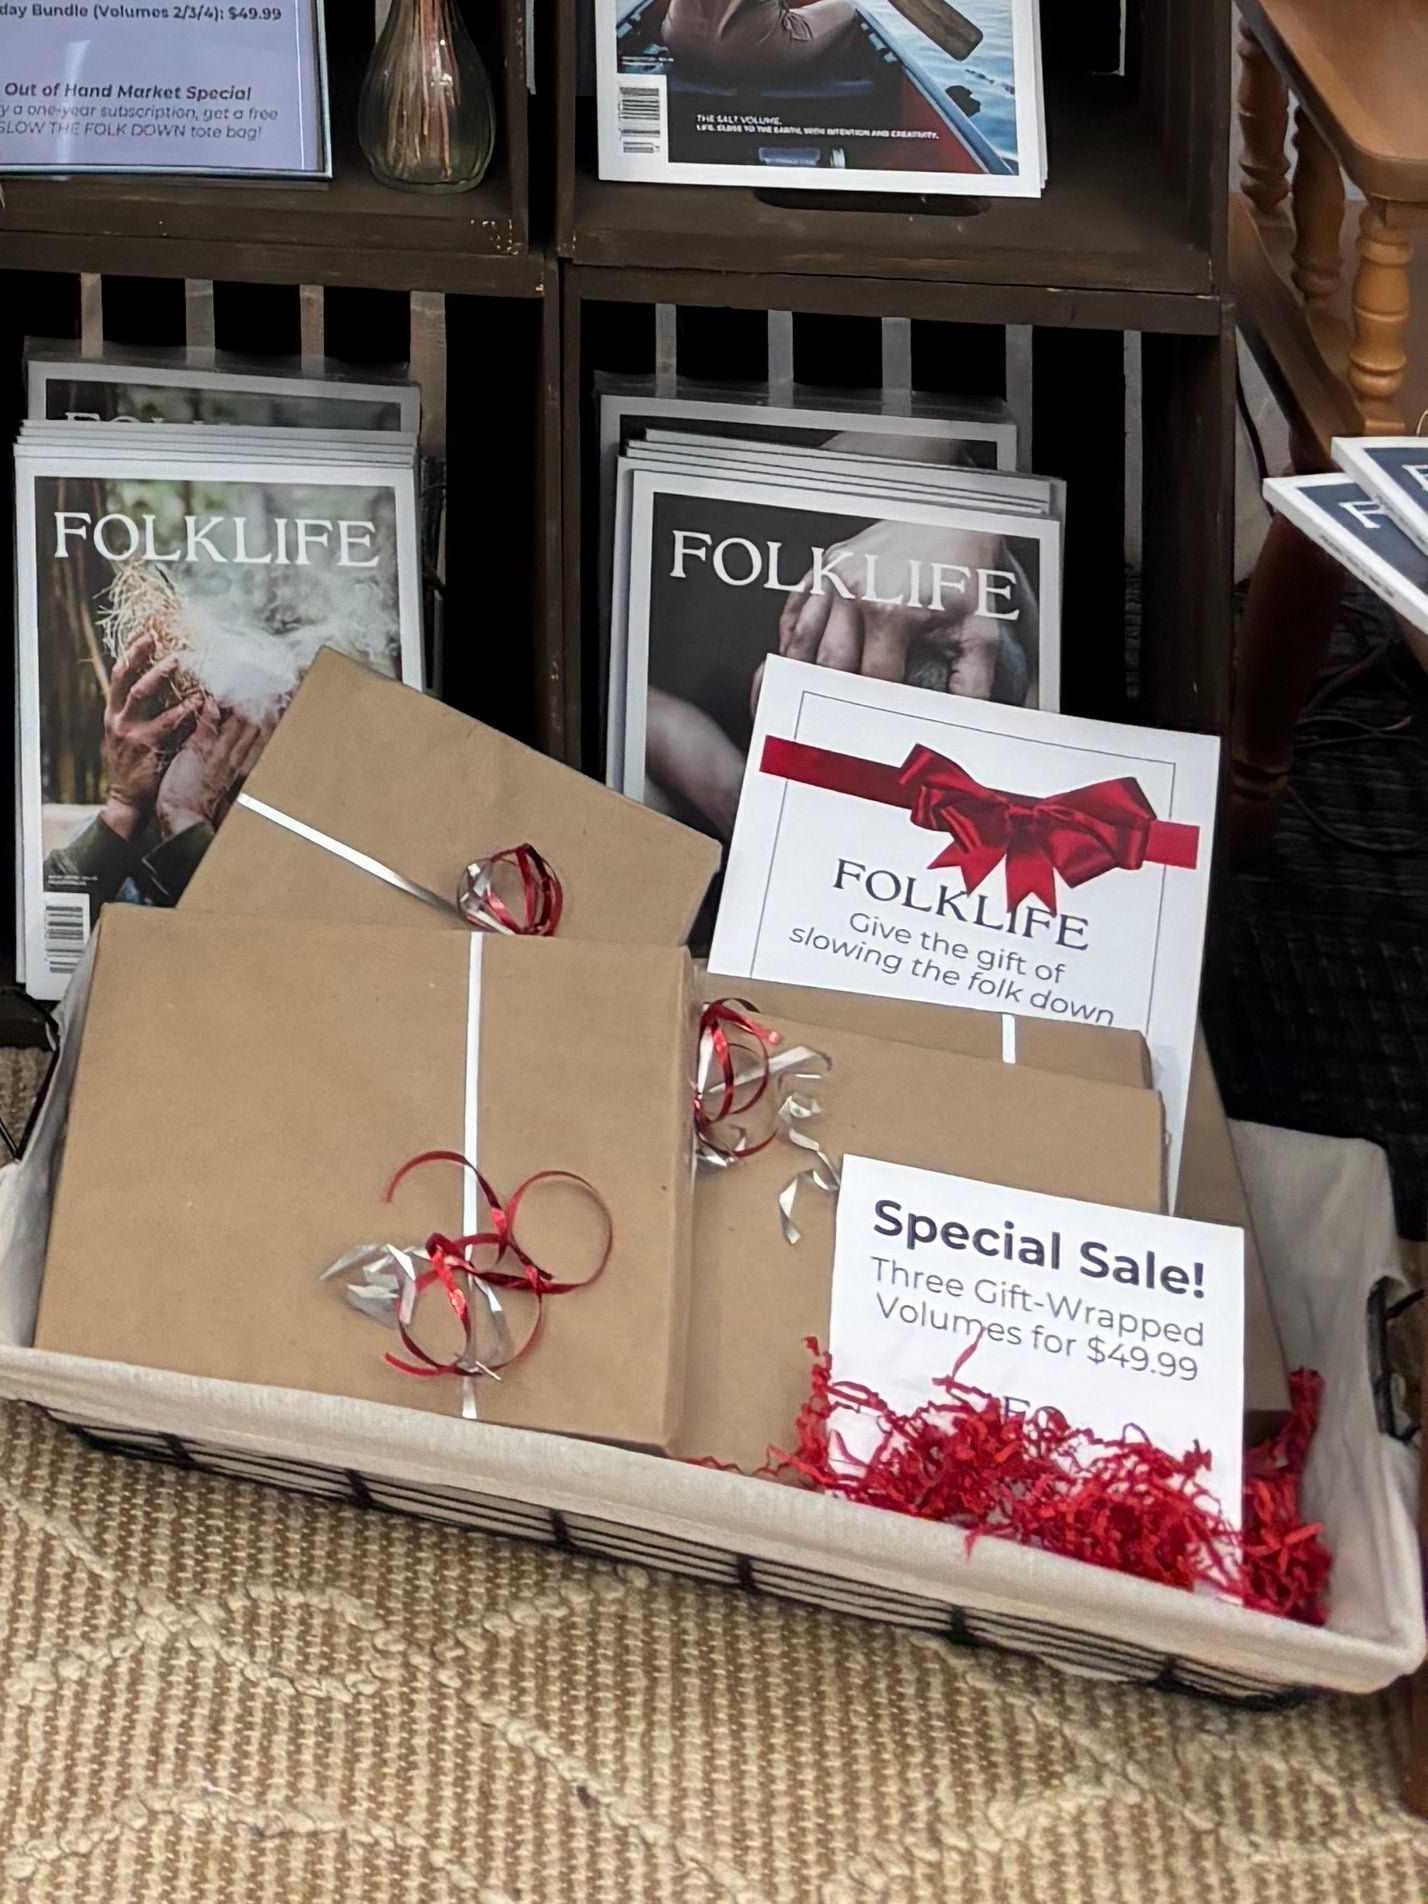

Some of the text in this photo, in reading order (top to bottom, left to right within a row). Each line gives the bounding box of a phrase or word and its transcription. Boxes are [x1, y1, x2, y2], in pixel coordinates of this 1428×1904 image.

[32, 3, 88, 17] Bundle
[93, 4, 169, 21] (Volumes
[228, 6, 282, 21] $49.99
[4, 82, 252, 102] Out of Hand Market Special
[13, 105, 23, 115] a
[27, 104, 97, 119] one-year
[100, 104, 198, 121] subscription,
[202, 108, 229, 122] get
[233, 110, 244, 119] a
[248, 107, 278, 120] free
[49, 121, 80, 135] THE
[85, 122, 127, 136] FOLK
[131, 123, 186, 137] DOWN
[191, 125, 222, 138] tote
[52, 511, 379, 568] FOLKLIFE
[669, 529, 1020, 621] FOLKLIFE
[833, 858, 1089, 952] FOLKLIFE
[789, 925, 1116, 1026] slowing the folk down
[849, 912, 1066, 984] Give the gift of
[873, 1199, 1205, 1299] Special Sale!
[870, 1255, 1204, 1348] Three Gift-Wrapped
[876, 1292, 1199, 1382] Volumes for $49.99
